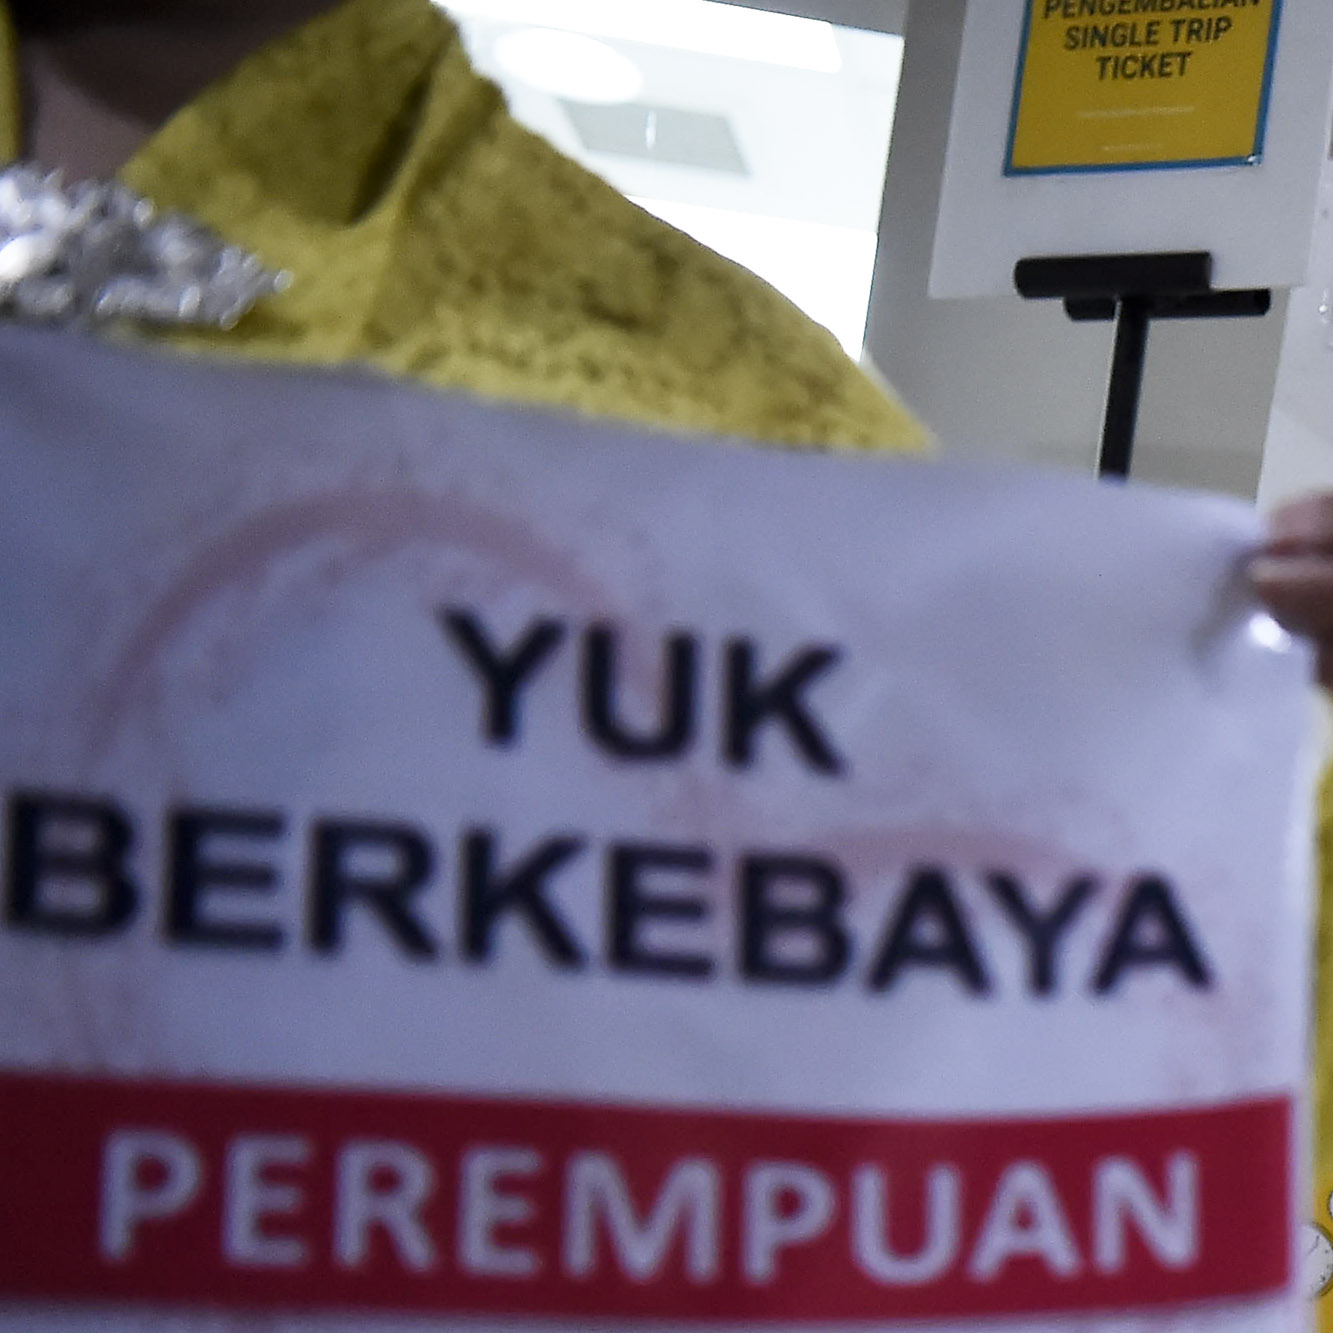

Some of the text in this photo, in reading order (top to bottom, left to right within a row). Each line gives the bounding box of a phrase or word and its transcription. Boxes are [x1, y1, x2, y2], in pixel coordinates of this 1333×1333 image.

[1042, 0, 1260, 19] PENGEM
[1063, 15, 1233, 49] SINGLE TRIP
[1096, 51, 1193, 80] TICKET
[435, 604, 851, 779] YUK
[0, 787, 1216, 998] BERKEBAYA
[98, 1129, 1200, 1286] PEREMPUAN
